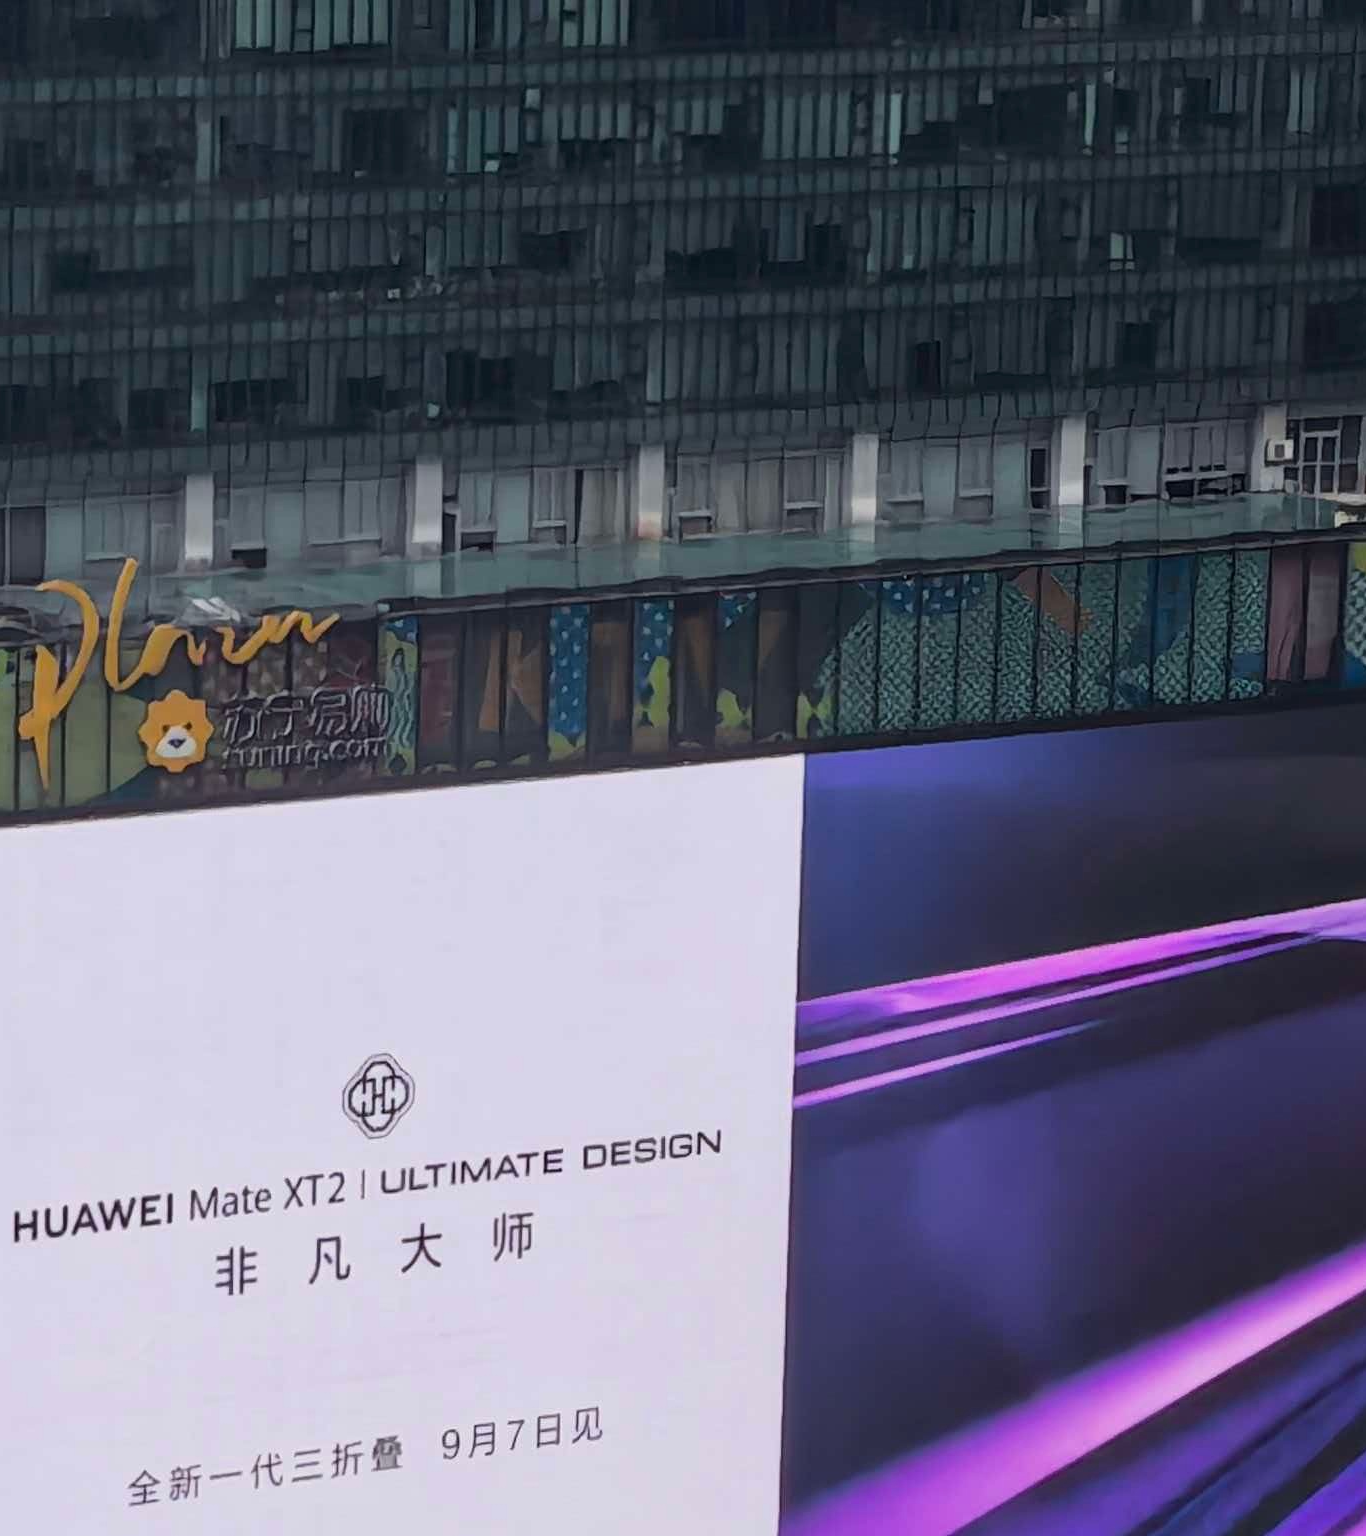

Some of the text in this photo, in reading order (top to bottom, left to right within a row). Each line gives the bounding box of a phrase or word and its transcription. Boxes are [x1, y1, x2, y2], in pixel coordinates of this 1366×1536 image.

[13, 1128, 722, 1244] HUAWEI Mate XT2 ULTIMATE DESIGN
[215, 1211, 535, 1296] 非凡大师
[127, 1405, 604, 1507] 全新一代三折叠 9月7日见
